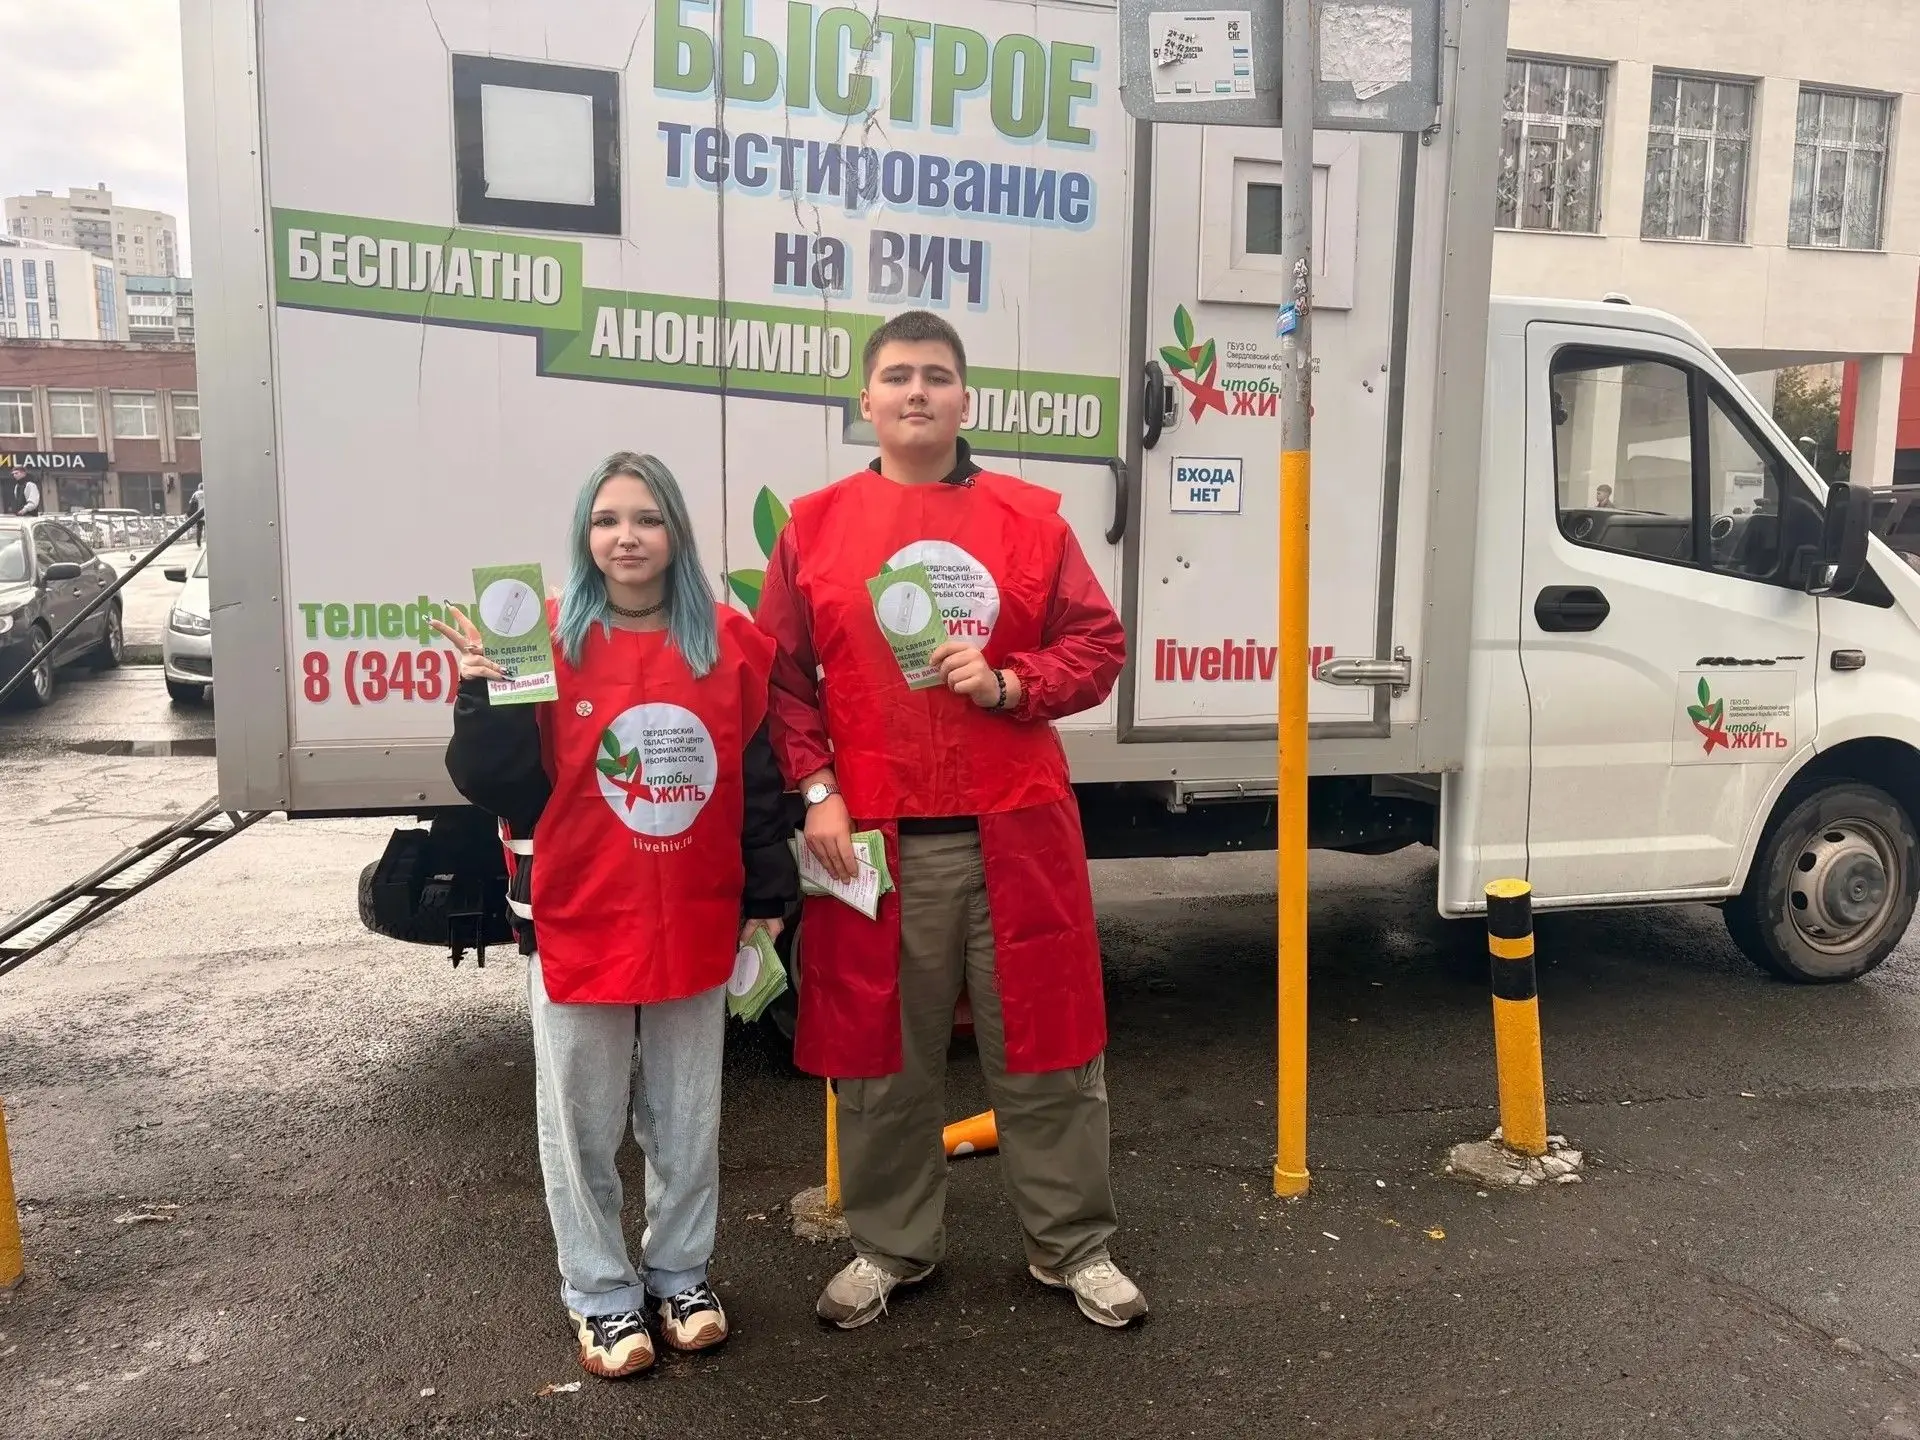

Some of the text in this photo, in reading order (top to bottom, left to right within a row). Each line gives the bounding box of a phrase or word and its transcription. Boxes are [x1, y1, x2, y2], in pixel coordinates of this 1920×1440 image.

[653, 0, 1097, 144] БЫСТРОЕ
[657, 120, 1091, 224] тестирование
[288, 228, 562, 305] БЕСПЛАТНО
[773, 231, 847, 291] на
[868, 229, 984, 304] ВИЧ
[589, 306, 851, 378] АНОНИМНО
[1246, 343, 1257, 351] СО
[1226, 351, 1270, 361] Свердловский
[1226, 361, 1267, 370] профилактики
[960, 385, 1101, 438] ОПАСНО
[1176, 467, 1235, 485] ВХОДА
[1189, 488, 1221, 502] НЕТ
[928, 573, 960, 581] ЛАСТНОЙ
[965, 591, 985, 599] СПИД
[940, 606, 971, 618] обы
[943, 620, 990, 636] ИТЬ
[484, 644, 537, 656] Вы сделали
[302, 649, 460, 705] 8 (343)
[642, 727, 694, 737] СВЕРДЛОВСКИЙ
[1725, 722, 1767, 733] чтобы
[643, 736, 705, 746] ОБЛАСТНОЙ ЦЕНТР
[1731, 732, 1788, 749] ЖИТЬ
[644, 746, 697, 755] ПРОФИЛАКТИКИ
[649, 756, 678, 764] БОРЬБЫ
[688, 755, 705, 763] СПИД
[646, 771, 692, 786] чтобы
[655, 785, 707, 804] ЖИТЬ
[633, 835, 693, 853] livehiv.ru
